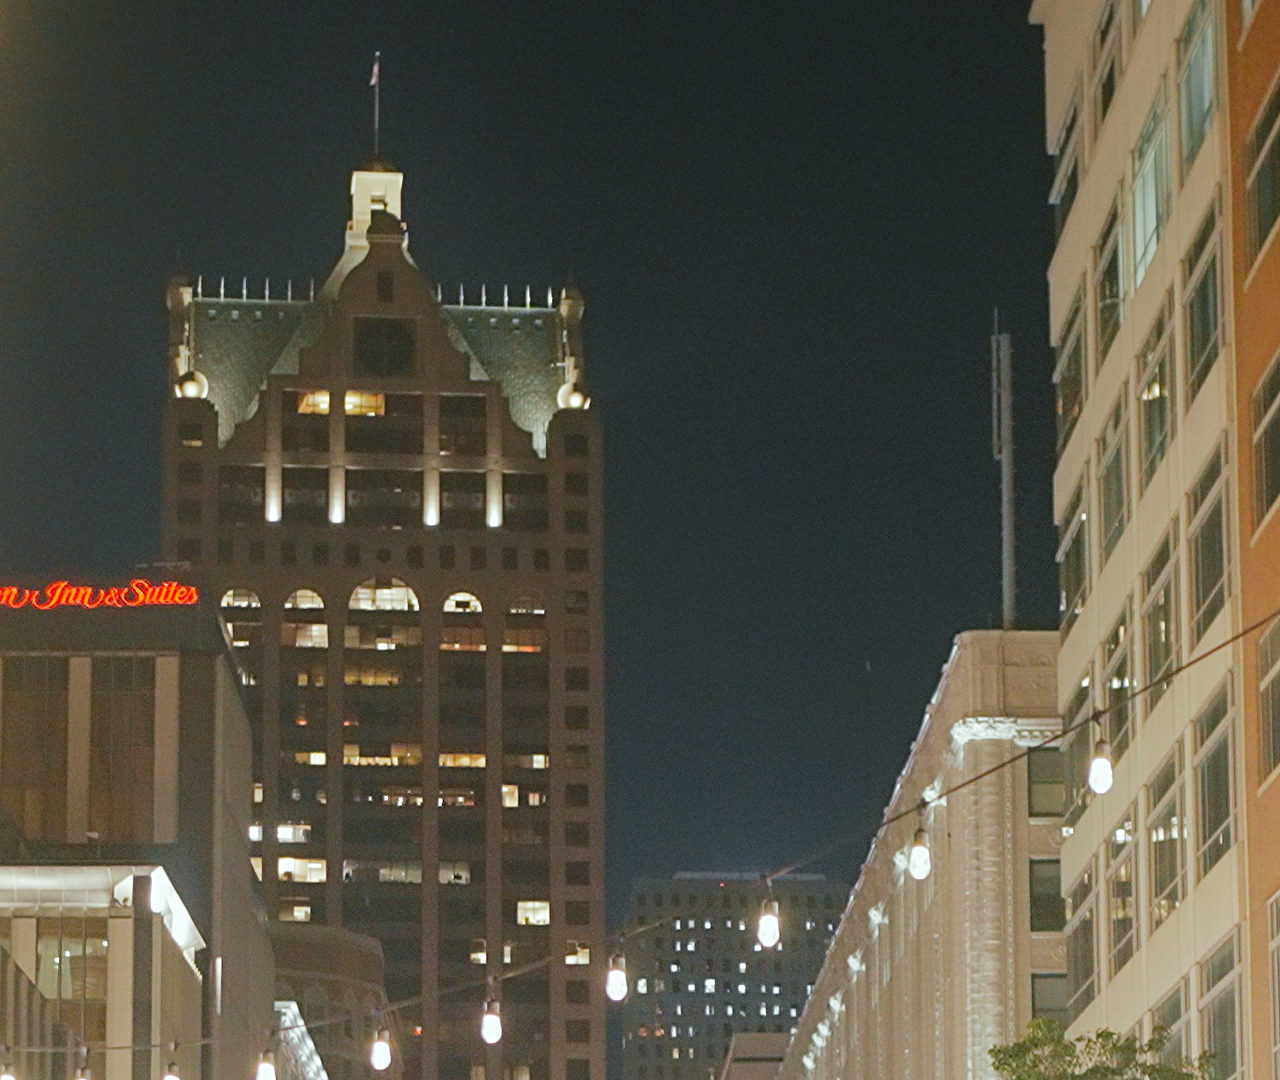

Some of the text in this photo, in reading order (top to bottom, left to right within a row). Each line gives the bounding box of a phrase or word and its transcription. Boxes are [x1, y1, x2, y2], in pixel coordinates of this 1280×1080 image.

[31, 580, 105, 610] Inn
[103, 586, 123, 608] &
[121, 579, 199, 607] Suites
